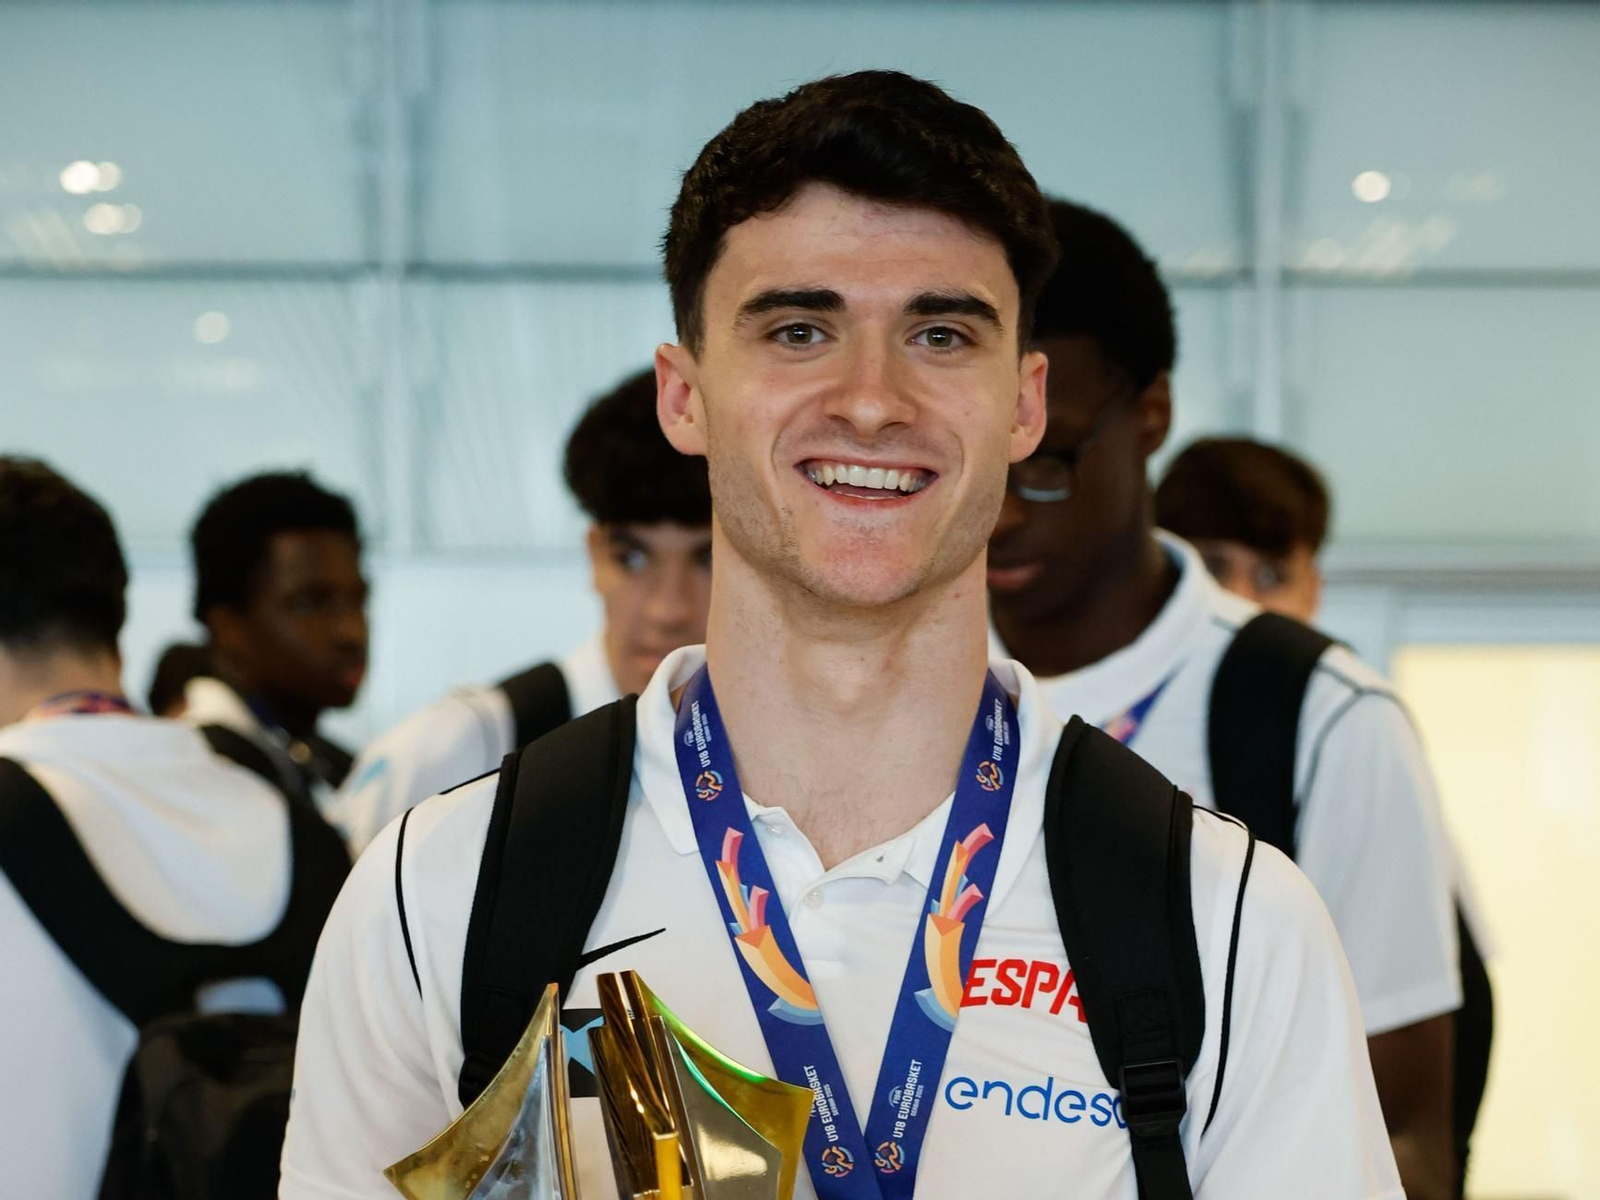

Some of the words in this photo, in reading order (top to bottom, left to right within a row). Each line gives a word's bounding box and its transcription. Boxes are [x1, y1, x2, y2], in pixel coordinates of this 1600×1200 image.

[803, 1065, 833, 1124] EUROBASKET
[898, 1059, 922, 1120] EUROBASKET
[824, 1124, 839, 1142] U18
[893, 1120, 906, 1138] U18
